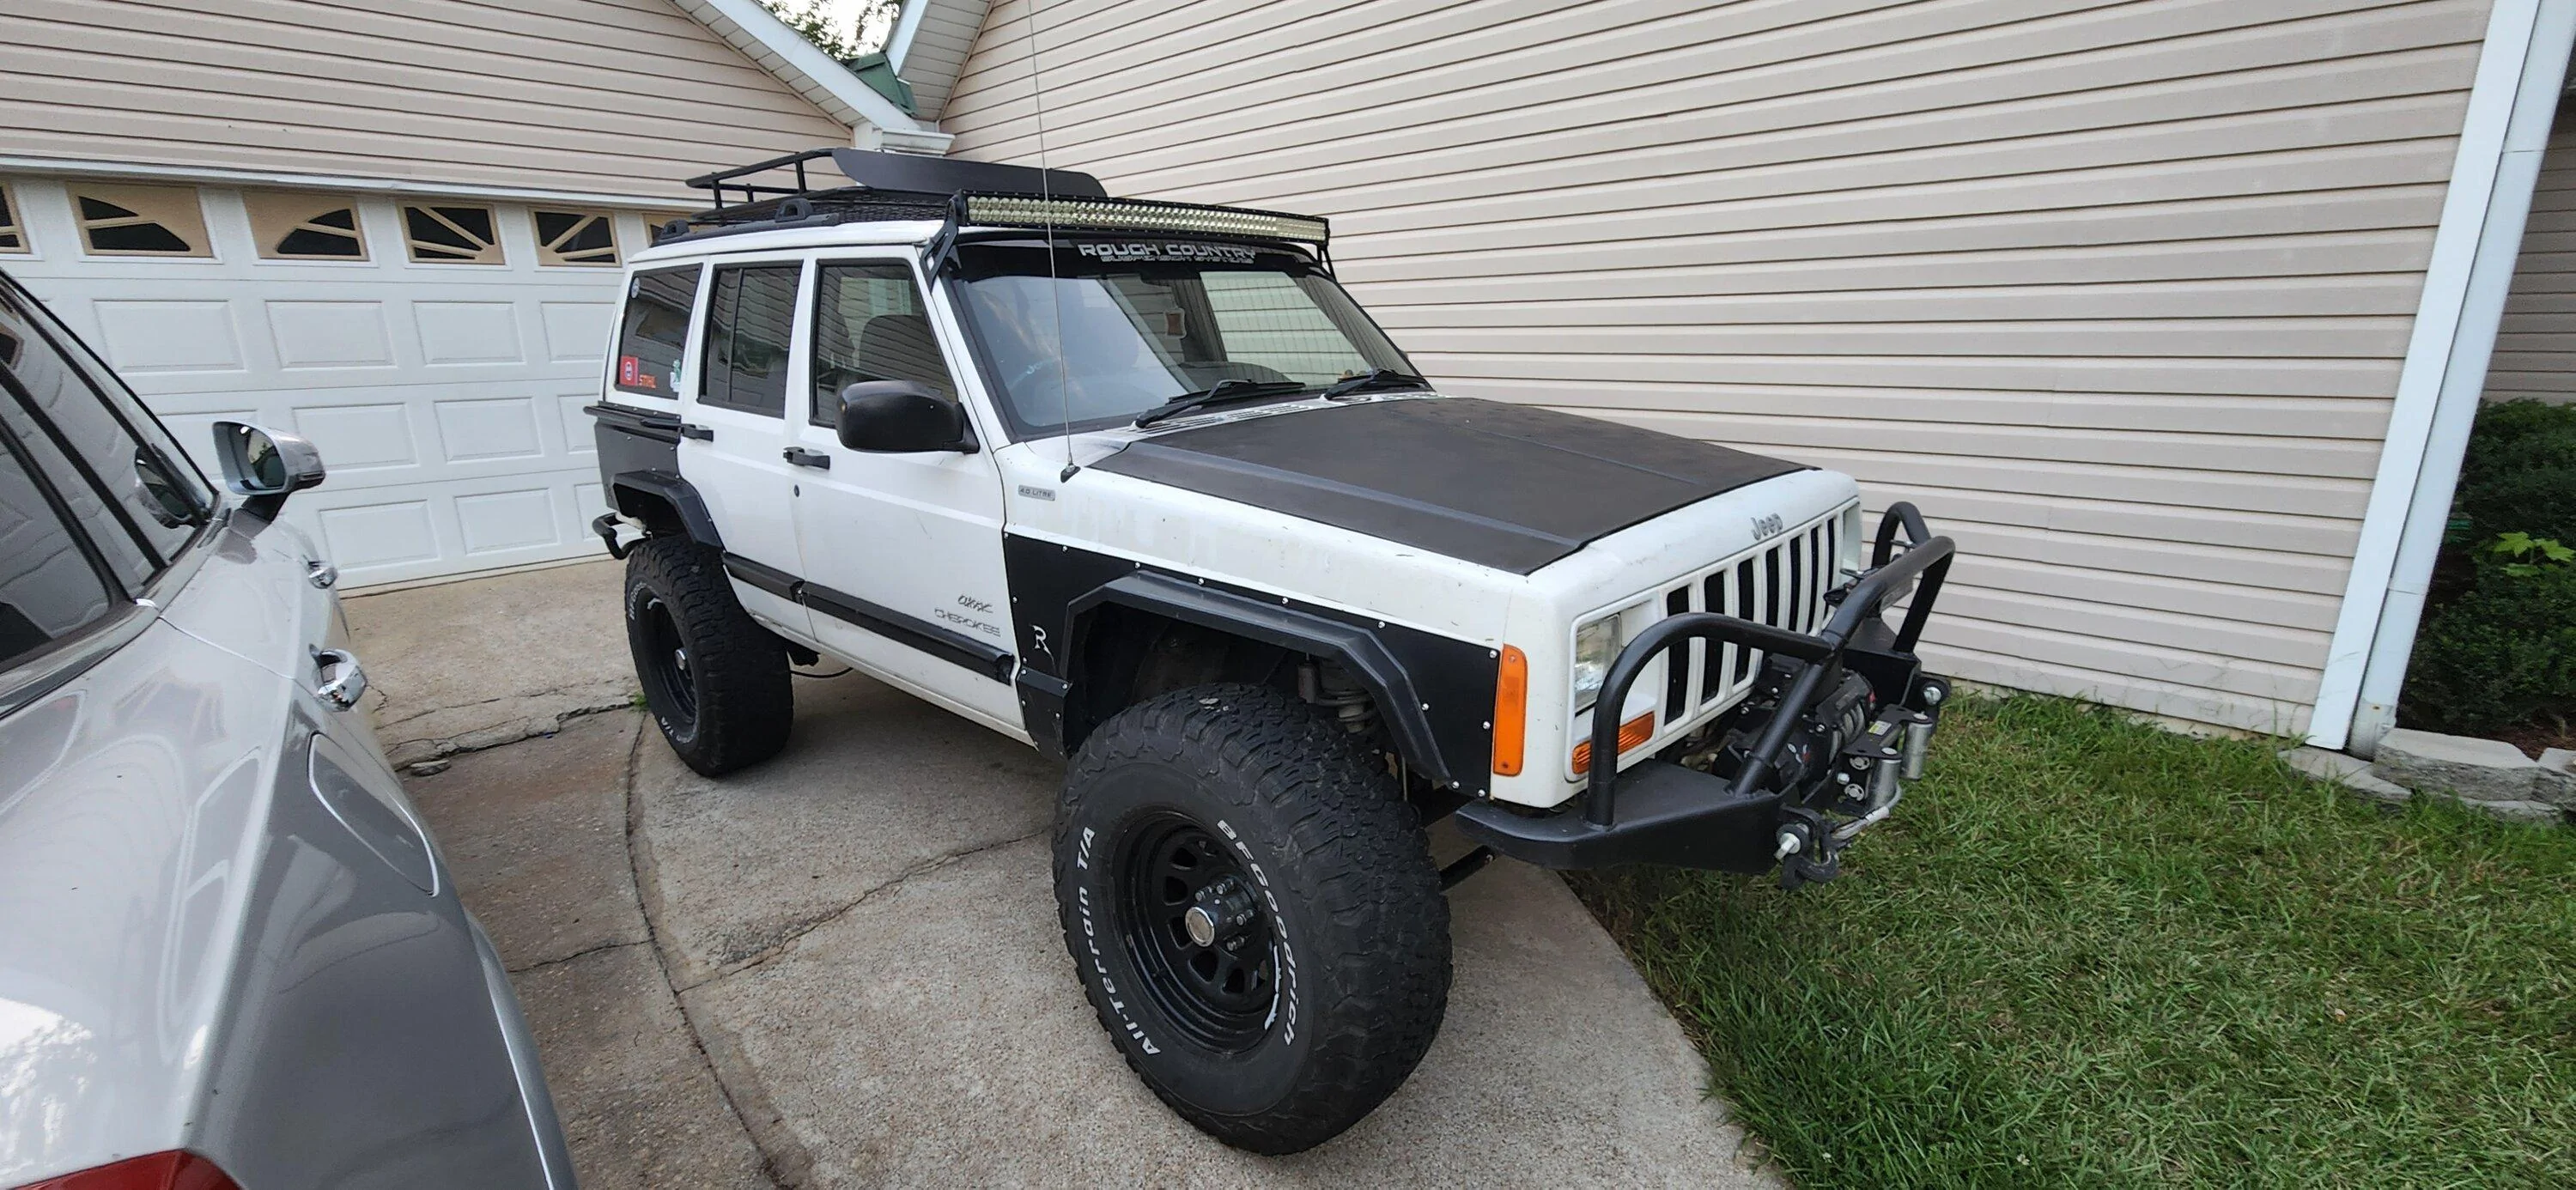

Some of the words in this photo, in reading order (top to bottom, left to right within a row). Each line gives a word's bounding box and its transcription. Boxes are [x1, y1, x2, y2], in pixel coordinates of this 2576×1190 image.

[1077, 244, 1160, 257] ROUGH
[1165, 244, 1256, 259] COUNTRY
[1751, 513, 1783, 540] Jeep
[1077, 827, 1096, 871] T/A
